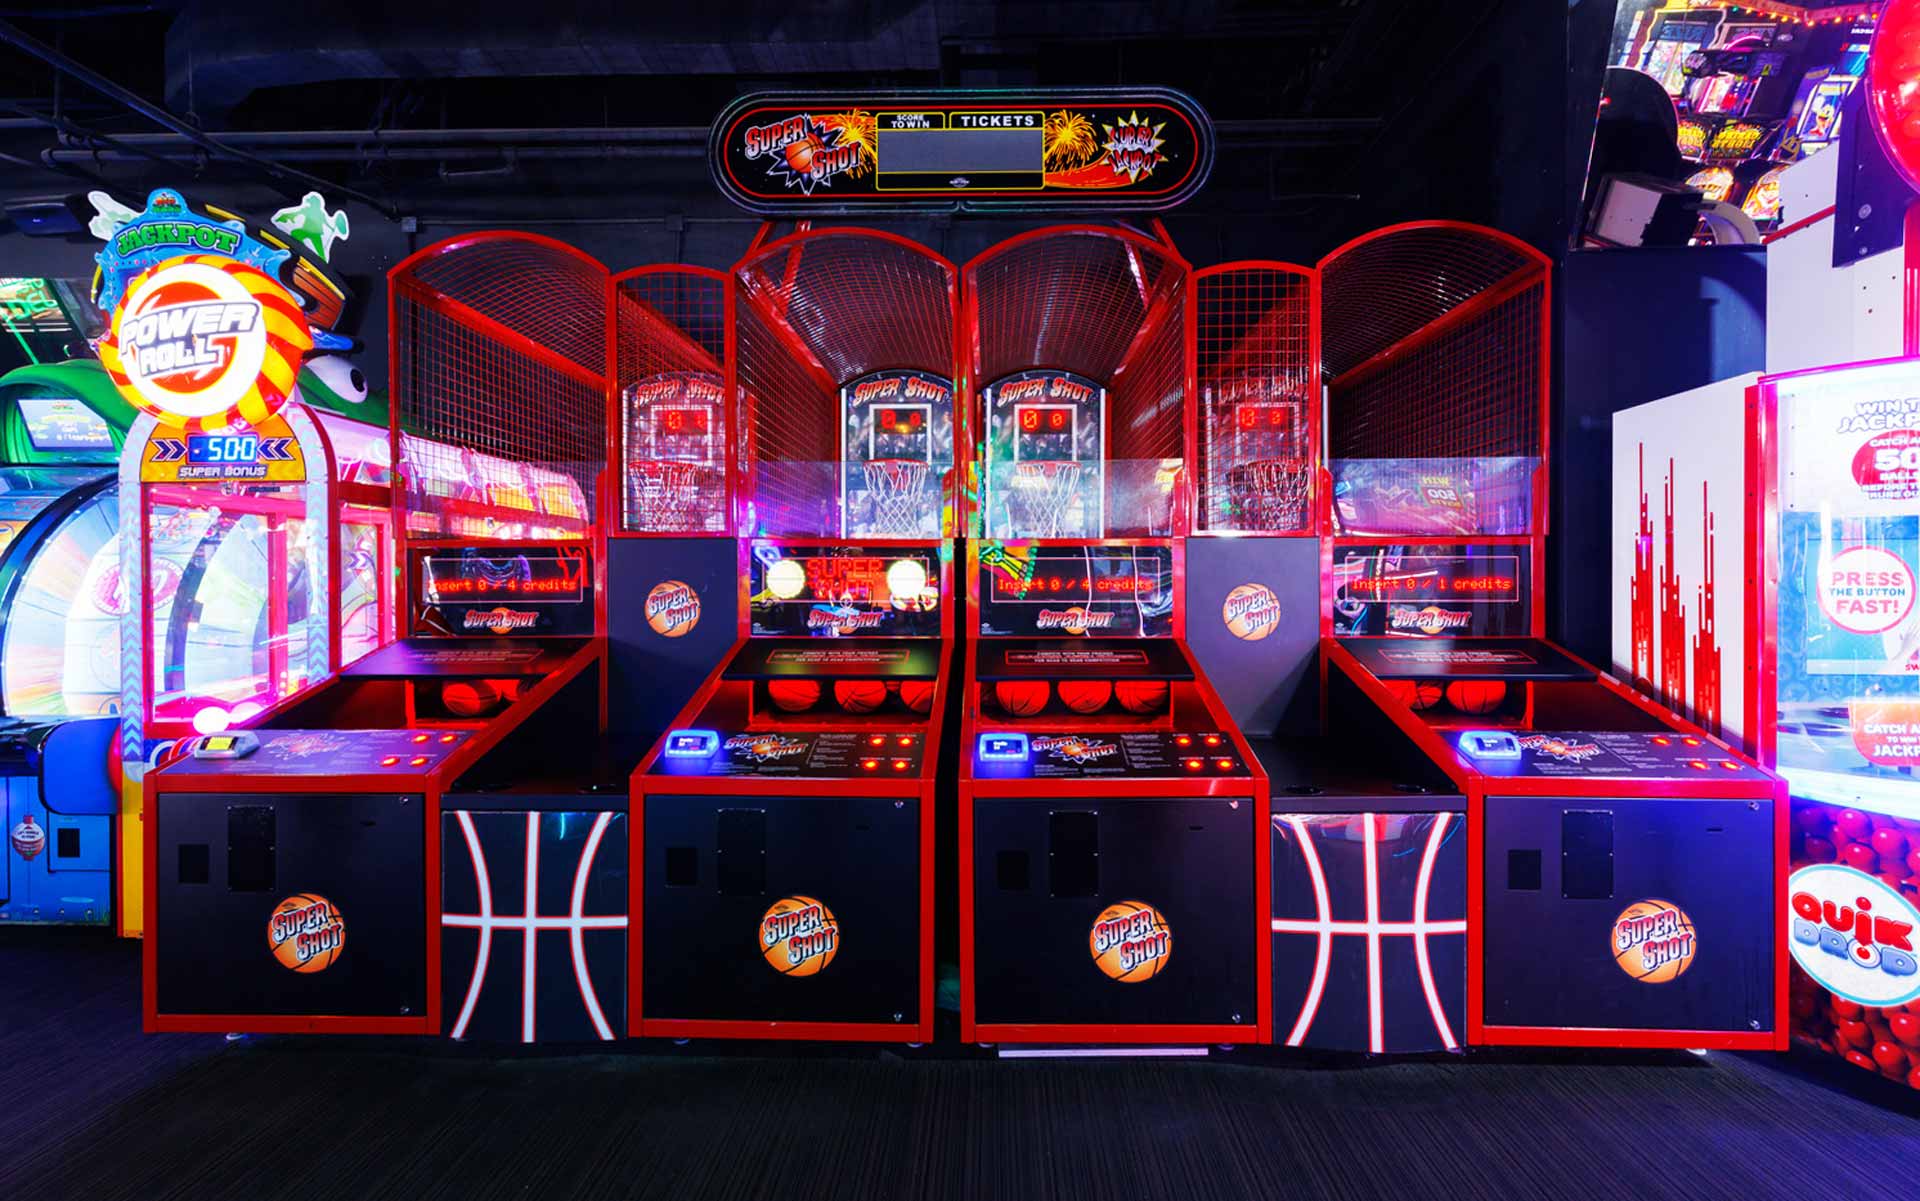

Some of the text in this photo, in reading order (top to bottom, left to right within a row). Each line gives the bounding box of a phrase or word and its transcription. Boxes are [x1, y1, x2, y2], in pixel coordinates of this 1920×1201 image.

[891, 120, 930, 129] TO WIN
[961, 115, 1035, 127] TICKETS
[745, 114, 806, 159] SUPER
[811, 140, 862, 181] SHOT
[117, 223, 239, 255] JACKPOT
[121, 302, 260, 355] POWER
[852, 376, 948, 407] SUPER SHOT
[997, 377, 1094, 407] SUPER SHOT
[1856, 399, 1902, 416] WIN
[1836, 412, 1920, 434] JACKP
[179, 466, 266, 477] SUPER BONUS
[807, 559, 883, 579] SUPER
[1832, 571, 1904, 586] PRESS
[430, 580, 473, 591] nsert
[508, 580, 516, 590] 4
[523, 579, 577, 591] credits
[1097, 579, 1154, 591] credits
[1454, 578, 1513, 590] credits
[1829, 588, 1905, 596] THE BUTTON
[649, 587, 689, 616] SUPER
[1228, 590, 1268, 619] SUPER
[1836, 599, 1899, 614] FAST!
[464, 610, 539, 628] SUPER SHOT
[665, 602, 699, 629] SHOT
[1037, 609, 1115, 628] SUPER SHOT
[1244, 605, 1279, 632] SHOT
[1392, 610, 1434, 628] SUPER
[1434, 609, 1472, 628] SHOT
[1864, 724, 1907, 734] CATCH
[1032, 737, 1074, 751] SUPER
[1872, 744, 1920, 757] JACKP
[273, 902, 328, 944] SUPER
[764, 904, 822, 946] SUPER
[1094, 909, 1154, 952] SUPER
[1616, 909, 1679, 951] SUPER
[296, 922, 343, 961] SHOT
[788, 926, 837, 965] SHOT
[1120, 931, 1168, 970] SHOT
[1642, 932, 1694, 970] SHOT
[1794, 917, 1918, 977] DROP
